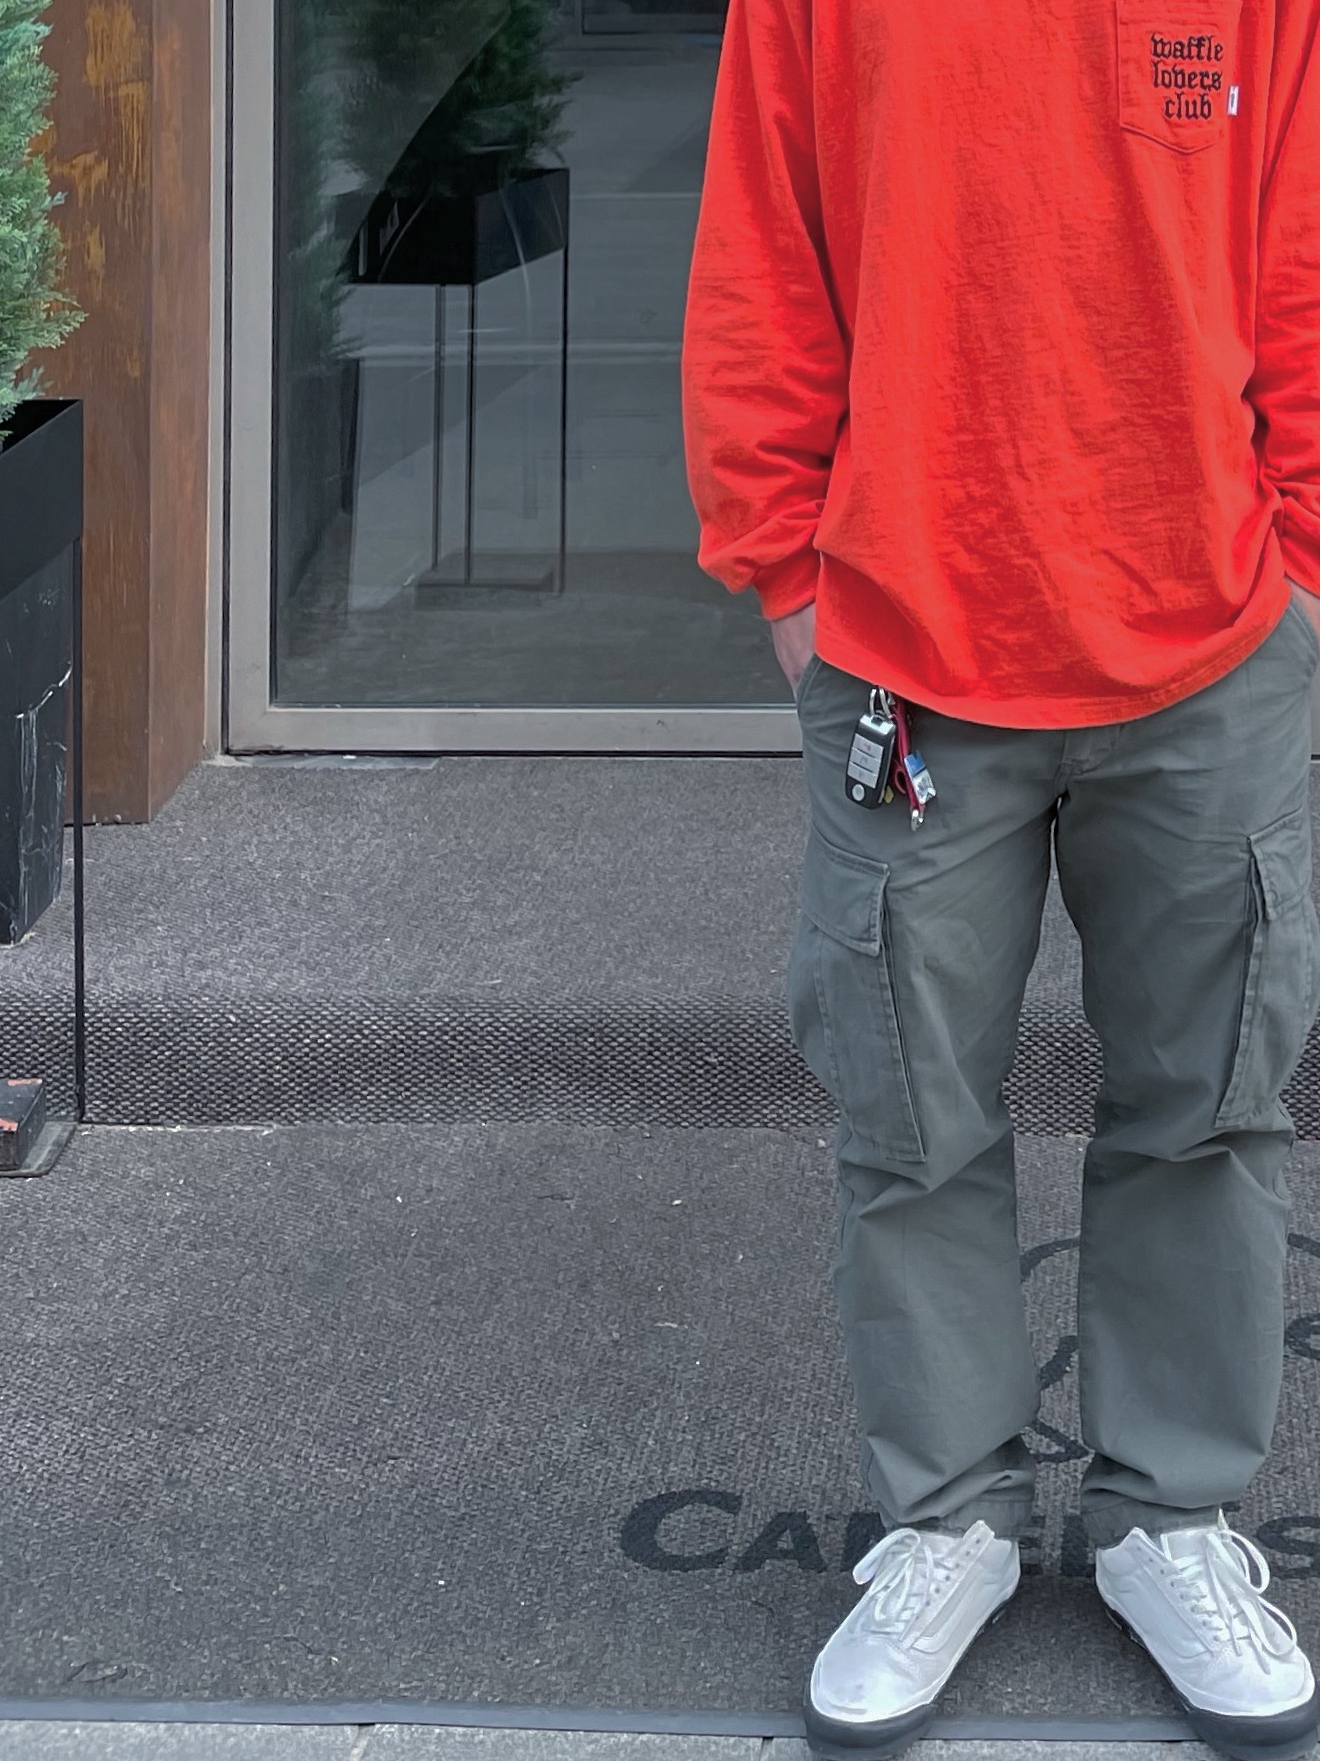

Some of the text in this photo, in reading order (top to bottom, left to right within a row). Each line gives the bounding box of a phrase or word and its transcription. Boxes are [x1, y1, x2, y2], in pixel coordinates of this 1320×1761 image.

[1150, 32, 1224, 62] waffle
[1150, 60, 1223, 92] lovers
[1164, 91, 1212, 120] club
